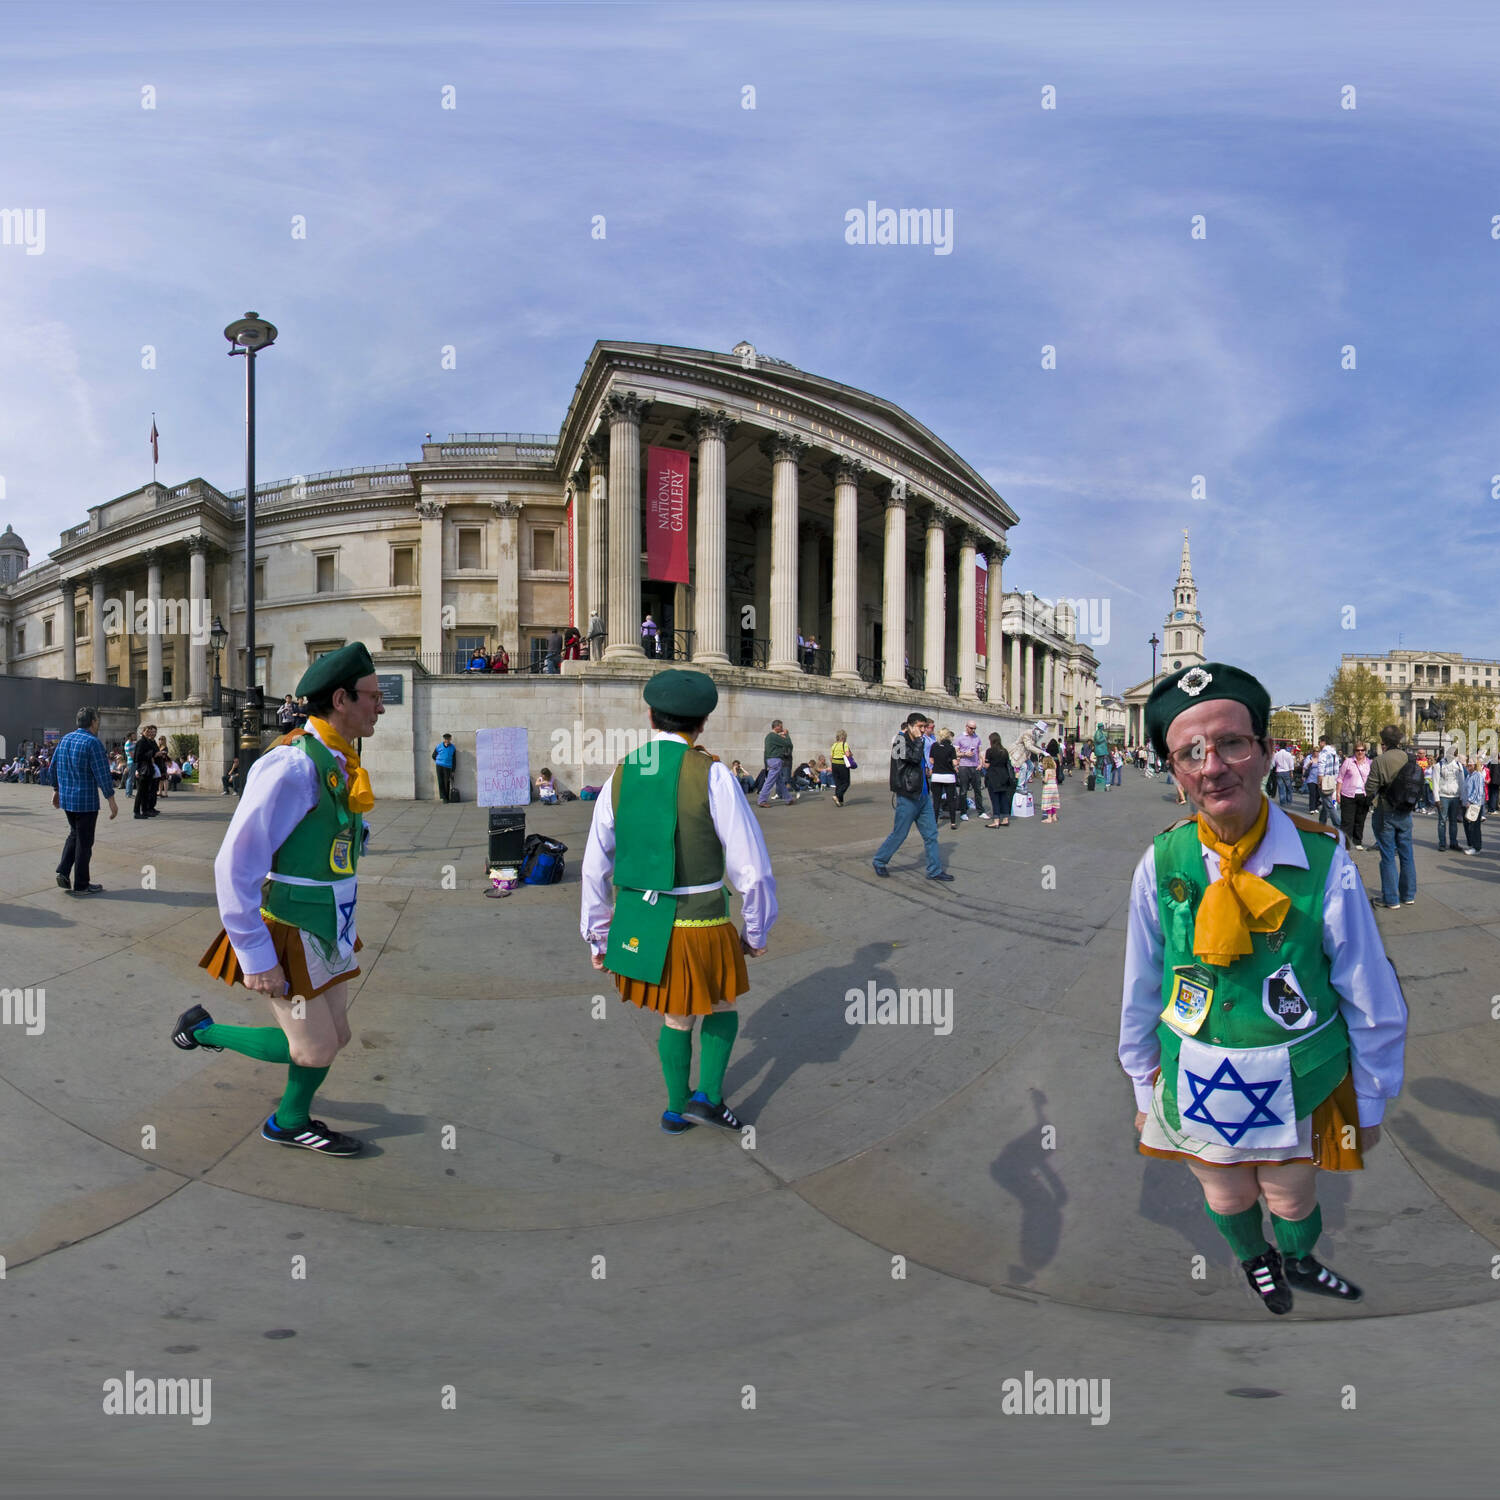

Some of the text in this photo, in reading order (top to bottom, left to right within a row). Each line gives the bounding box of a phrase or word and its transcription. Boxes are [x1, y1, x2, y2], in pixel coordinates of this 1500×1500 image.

[658, 468, 670, 530] NATIONAL
[670, 470, 684, 532] GALLERY
[484, 775, 528, 792] ENGLAND
